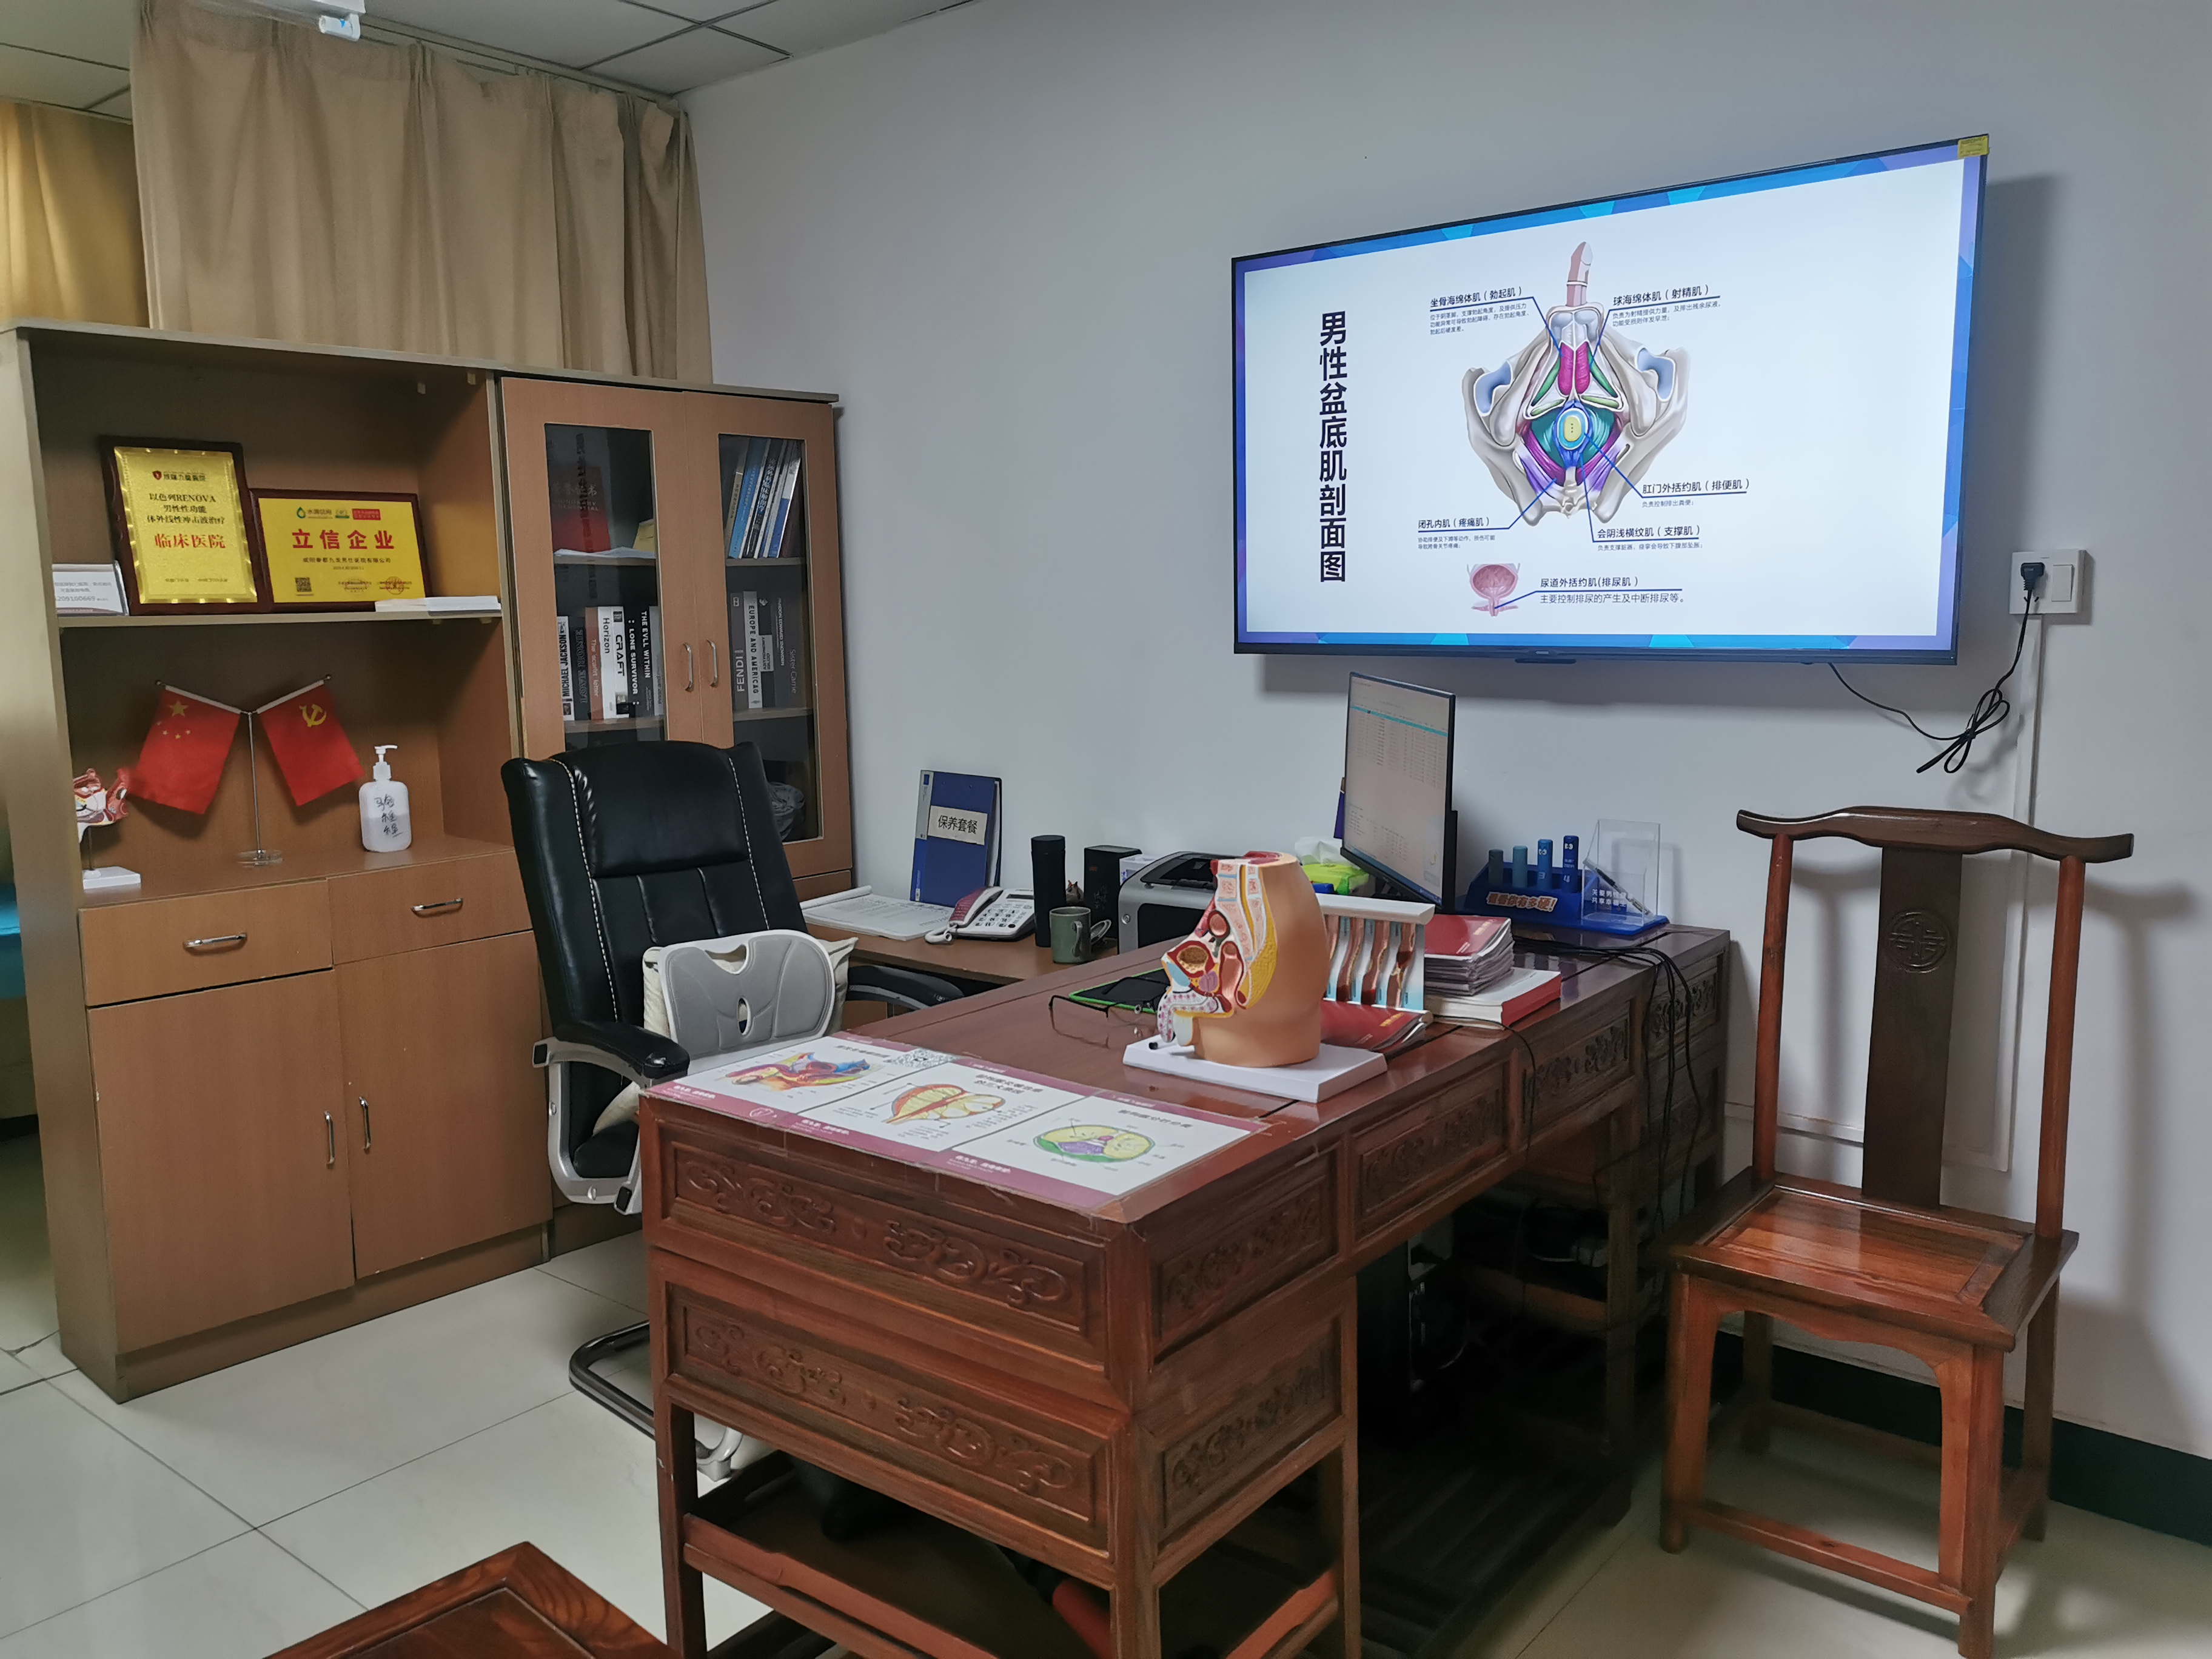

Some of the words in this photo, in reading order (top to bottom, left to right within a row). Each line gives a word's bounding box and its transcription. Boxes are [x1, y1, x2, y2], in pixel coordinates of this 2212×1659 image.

[1319, 310, 1347, 582] 男性盆底肌剖面图
[1642, 478, 1749, 494] 肛门外括约肌（排便肌）
[149, 493, 216, 503] 以色列RENOVA
[164, 505, 207, 514] 男性性功能
[155, 534, 226, 549] 临床医院
[292, 529, 394, 549] 立信企业
[1540, 593, 1684, 603] 主要控制排尿的产生及中断排尿等。
[559, 635, 568, 666] JACKSON
[615, 635, 625, 677] CRAFT
[561, 668, 570, 697] MICHAEL
[630, 652, 638, 694] SURVIVOR
[736, 655, 745, 692] FENDI
[938, 815, 977, 834] 保养套餐
